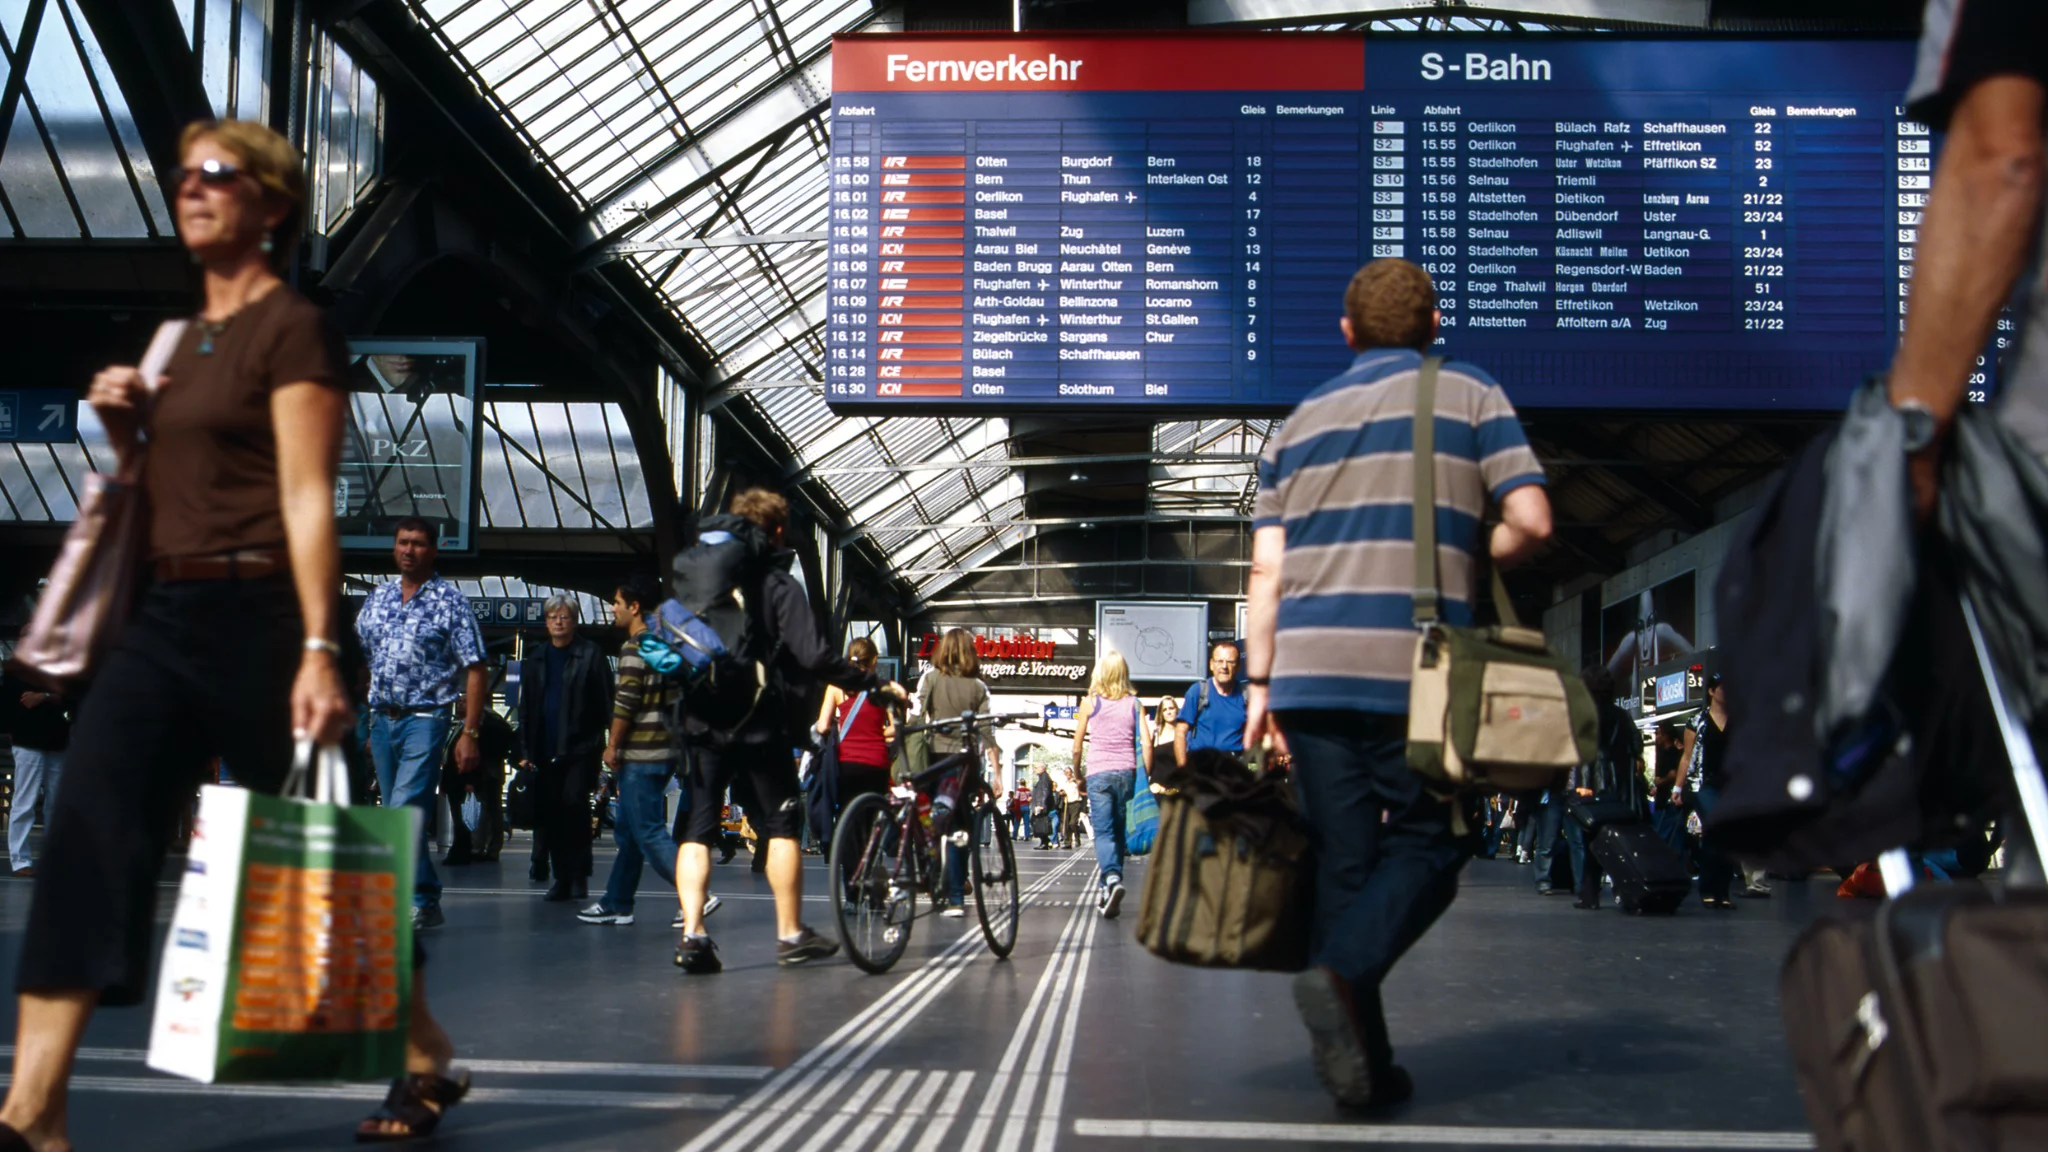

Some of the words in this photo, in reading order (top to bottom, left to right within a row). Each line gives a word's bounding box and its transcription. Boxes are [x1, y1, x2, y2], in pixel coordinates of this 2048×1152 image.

[887, 53, 1082, 82] Fernverkehr
[1421, 52, 1551, 81] S-Bahn
[838, 106, 875, 116] Abfahrt
[1240, 105, 1266, 114] Gleis
[1276, 105, 1344, 116] Bemerkungen
[1371, 105, 1396, 115] Linie
[1424, 105, 1461, 115] Abfahrt
[1750, 106, 1776, 116] Gleis
[1786, 106, 1856, 118] Bemerkungen
[1422, 121, 1456, 132] 15.55
[1468, 122, 1516, 133] Oerlikon
[1555, 122, 1597, 133] Bülach
[1604, 122, 1630, 133] Rafz
[1643, 122, 1726, 134] Schaffhausen
[1754, 122, 1771, 134] 22
[1422, 139, 1456, 150] 15.55
[1468, 139, 1516, 150] Oerlikon
[1555, 140, 1614, 152] Flughafen
[1644, 140, 1701, 151] Effretikon
[1755, 140, 1772, 152] 52
[835, 156, 870, 168] 15.58
[976, 156, 1008, 167] Olten
[1062, 156, 1113, 169] Burgdorf
[1147, 156, 1175, 167] Bern
[1247, 156, 1261, 167] 18
[1422, 157, 1456, 168] 15.55
[1468, 157, 1538, 168] Stadelhofen
[1555, 158, 1578, 168] Uster
[1644, 157, 1698, 169] Pfäffikon
[1700, 157, 1717, 169] SZ
[1755, 158, 1772, 169] 23
[834, 174, 869, 185] 16.00
[975, 174, 1003, 185] Bern
[1061, 173, 1091, 185] Thun
[1147, 173, 1204, 184] Interlaken
[1207, 173, 1229, 184] Ost
[1247, 173, 1261, 184] 12
[1422, 174, 1456, 185] 15.56
[1468, 174, 1509, 186] Selnau
[1556, 175, 1596, 186] Triemli
[1759, 175, 1768, 187] 2
[834, 191, 867, 203] 16.01
[975, 191, 1023, 202] Oerlikon
[1061, 191, 1119, 204] Flughafen
[1248, 191, 1257, 201] 4
[1422, 192, 1456, 203] 15.58
[1468, 192, 1526, 203] Altstetten
[1555, 193, 1605, 204] Dietikon
[1744, 193, 1783, 205] 21/22
[834, 208, 868, 220] 16.02
[975, 208, 1007, 220] Basel
[1246, 209, 1261, 219] 17
[1422, 210, 1456, 221] 15.58
[1468, 210, 1538, 221] Stadelhofen
[1555, 210, 1619, 221] Dübendorf
[1644, 211, 1677, 222] Uster
[1744, 211, 1783, 222] 23/24
[834, 226, 868, 237] 16.04
[975, 226, 1017, 237] Thalwil
[1060, 226, 1084, 239] Zug
[1146, 226, 1185, 237] Luzern
[1248, 226, 1257, 237] 3
[1422, 227, 1456, 238] 15.58
[1468, 227, 1509, 239] Selnau
[1556, 228, 1602, 239] Adliswil
[833, 243, 868, 255] 16.04
[882, 243, 904, 255] ICN
[974, 243, 1009, 255] Aarau
[1015, 243, 1038, 255] Biel
[1060, 243, 1121, 255] Neuchâtel
[1146, 243, 1191, 255] Genève
[1246, 244, 1261, 255] 13
[1422, 245, 1456, 256] 16.00
[1468, 245, 1538, 256] Stadelhofen
[1644, 247, 1690, 257] Uetikon
[1744, 247, 1783, 258] 23/24
[833, 261, 867, 272] 16.06
[974, 261, 1012, 272] Baden
[1017, 261, 1052, 274] Brugg
[1060, 261, 1095, 272] Aarau
[1101, 261, 1133, 272] Olten
[1146, 261, 1174, 272] Bern
[1246, 262, 1260, 272] 14
[1468, 263, 1516, 274] Oerlikon
[1555, 264, 1643, 277] Regensdorf-W
[1644, 264, 1682, 275] Baden
[1744, 265, 1783, 276] 21/22
[833, 278, 867, 290] 16.07
[973, 278, 1031, 291] Flughafen
[1060, 278, 1123, 290] Winterthur
[1146, 278, 1218, 290] Romanshorn
[1247, 279, 1256, 290] 8
[1467, 280, 1497, 293] Enge
[1504, 281, 1546, 292] Thalwil
[1755, 283, 1770, 294] 51
[832, 295, 867, 307] 16.09
[973, 296, 1045, 307] Arth-Goldau
[1059, 296, 1118, 307] Bellinzona
[1146, 296, 1192, 308] Locarno
[1248, 297, 1256, 307] 5
[1468, 298, 1538, 310] Stadelhofen
[1555, 299, 1613, 310] Effretikon
[1644, 300, 1698, 311] Wetzikon
[1745, 300, 1784, 311] 23/24
[832, 313, 867, 324] 16.10
[881, 313, 903, 325] ICN
[973, 313, 1030, 326] Flughafen
[1059, 314, 1123, 325] Winterthur
[1248, 314, 1256, 325] 7
[1468, 316, 1527, 327] Altstetten
[1556, 317, 1608, 328] Affoltern
[1611, 317, 1632, 328] a/A
[1644, 317, 1667, 330] Zug
[1745, 318, 1784, 330] 21/22
[832, 330, 866, 342] 16.12
[973, 331, 1048, 344] Ziegelbrücke
[1059, 331, 1108, 344] Sargans
[1145, 331, 1174, 343] Chur
[1247, 332, 1256, 343] 6
[832, 348, 866, 359] 16.14
[972, 348, 1013, 360] Bülach
[1059, 348, 1140, 360] Schaffhausen
[1247, 349, 1256, 361] 9
[831, 365, 866, 377] 16.28
[880, 366, 902, 377] ICE
[972, 365, 1005, 377] Basel
[831, 383, 866, 394] 16.30
[880, 383, 902, 395] ICN
[972, 383, 1004, 395] Olten
[1059, 384, 1115, 395] Solothurn
[1145, 384, 1168, 395] Biel
[372, 438, 429, 457] PKZ
[1032, 662, 1087, 680] Vorsorge
[1662, 677, 1684, 702] kiosk
